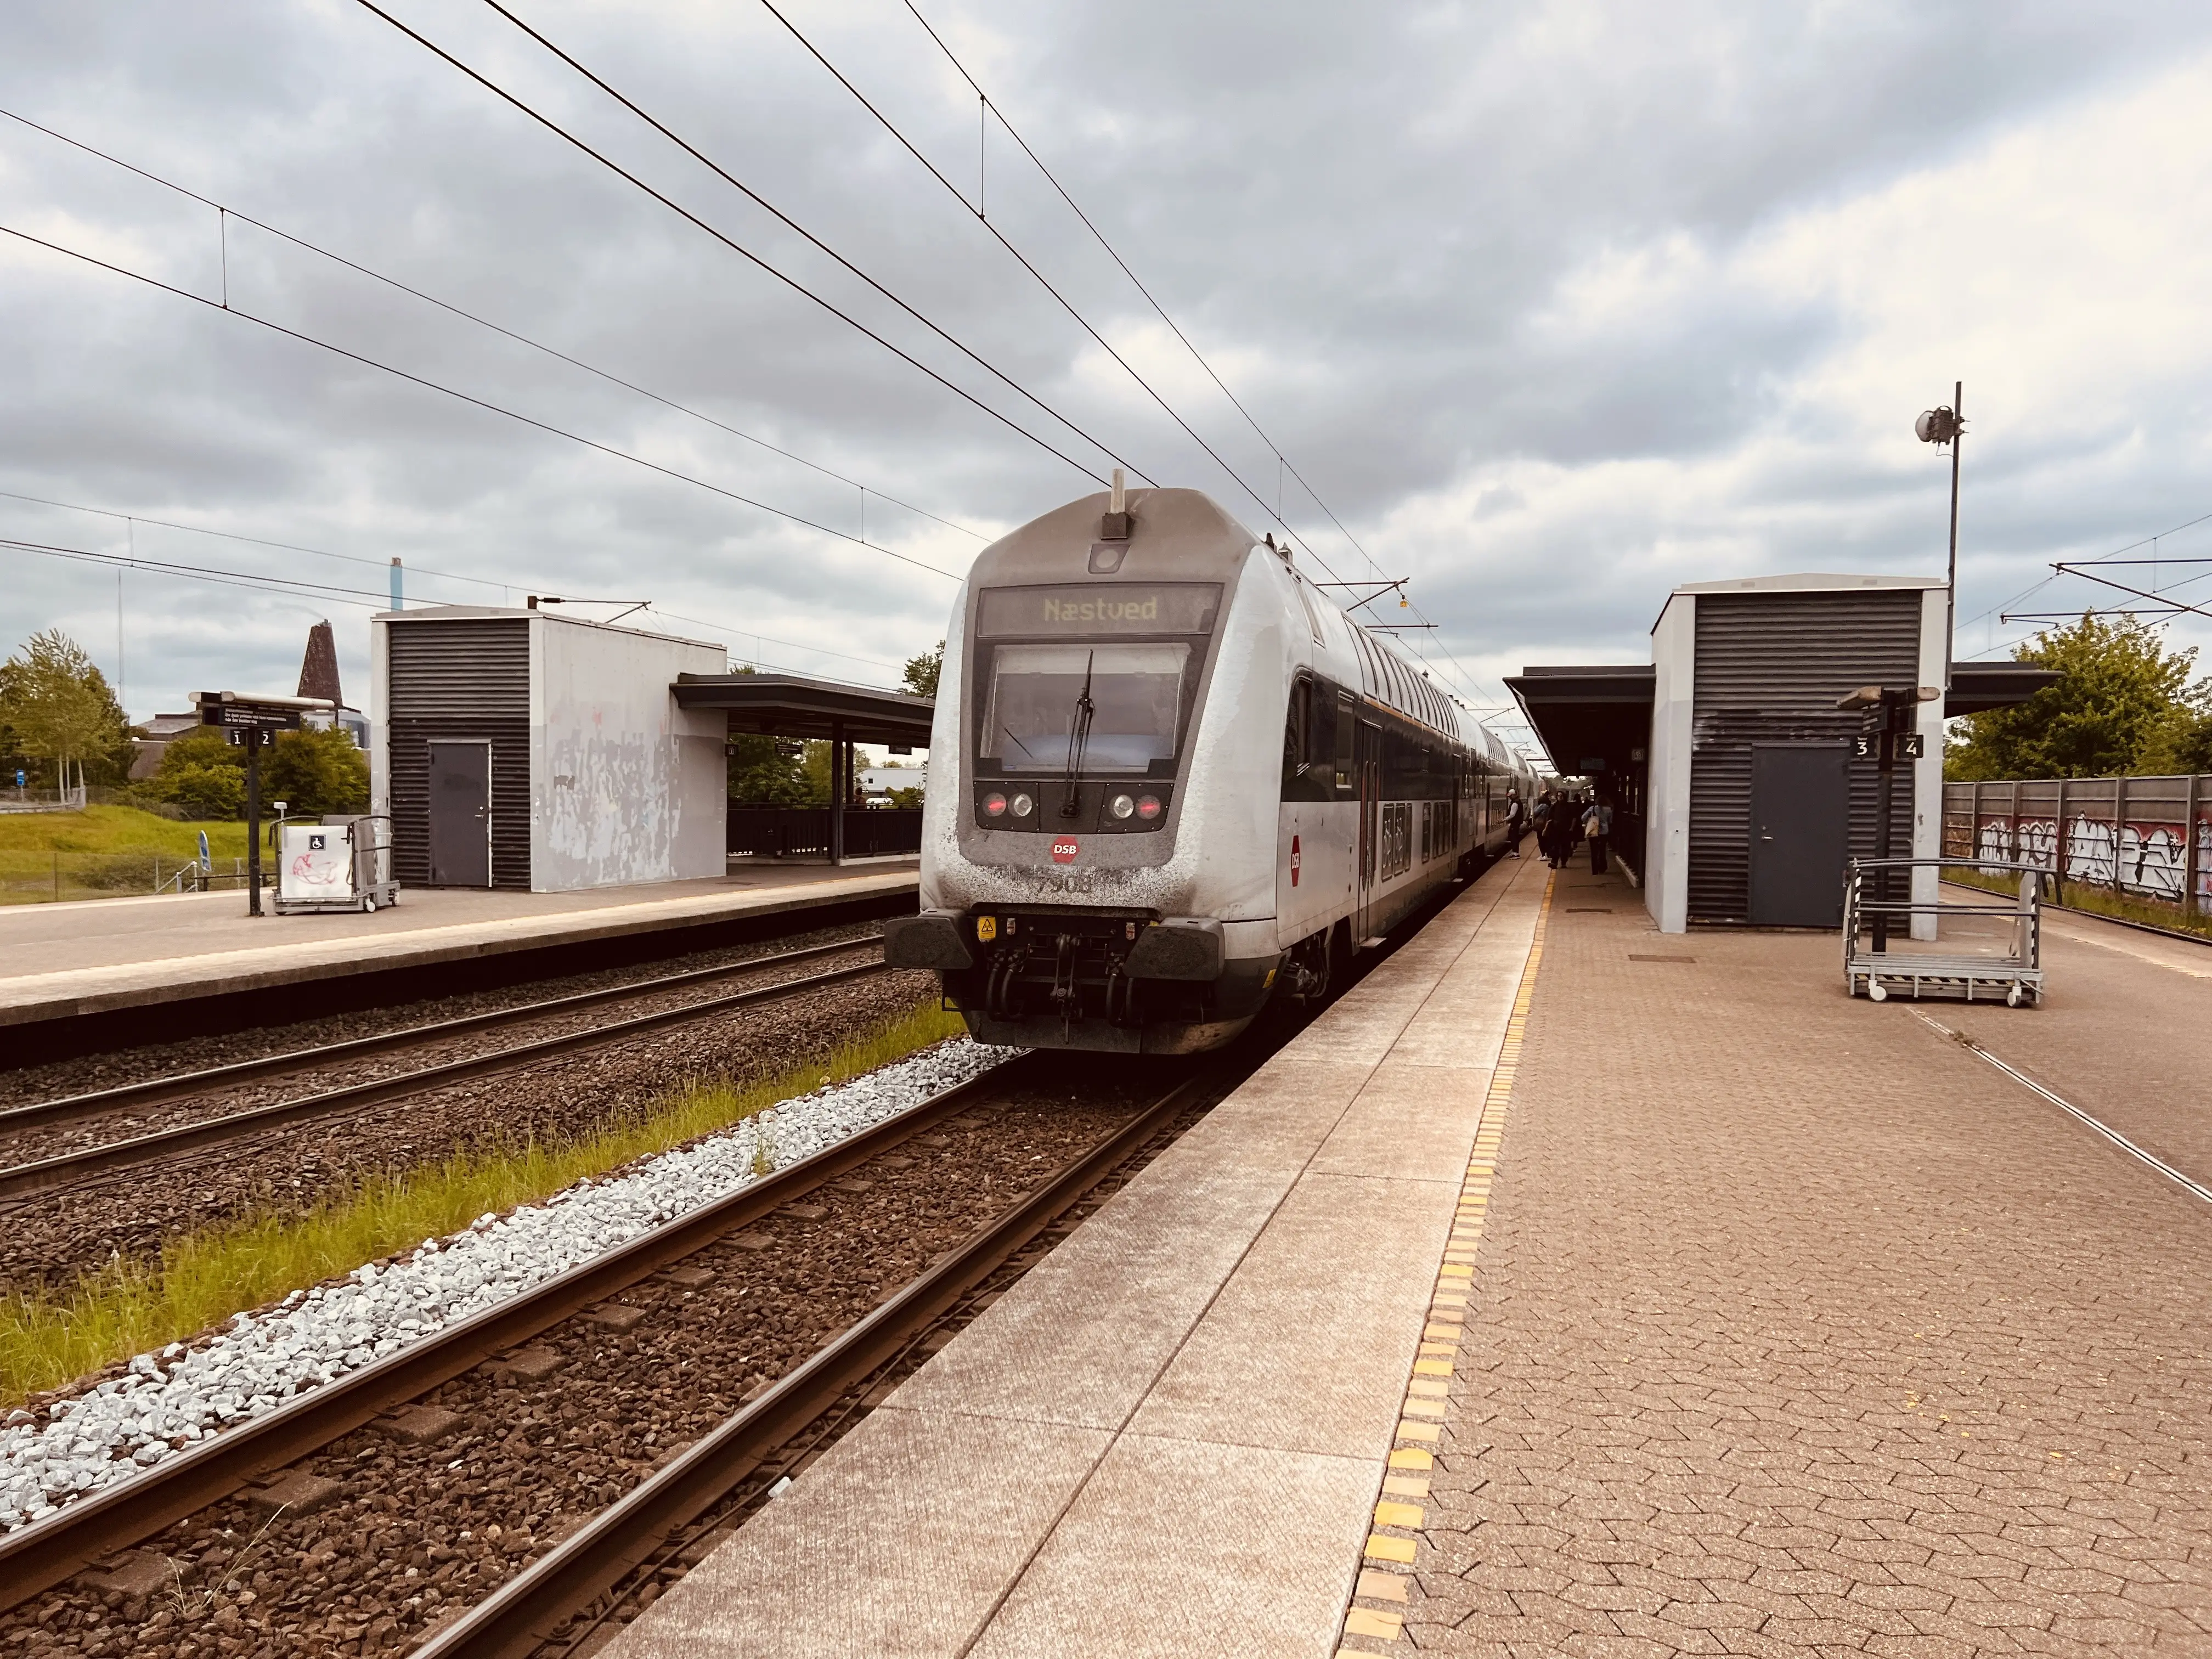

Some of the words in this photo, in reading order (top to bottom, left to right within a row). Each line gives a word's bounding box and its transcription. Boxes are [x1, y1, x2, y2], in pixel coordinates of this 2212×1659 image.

[1045, 596, 1157, 621] Næstved
[234, 734, 241, 744] 1
[262, 733, 269, 744] 2
[1857, 742, 1867, 755] 3
[1906, 742, 1917, 755] 4
[1053, 844, 1077, 854] DSB
